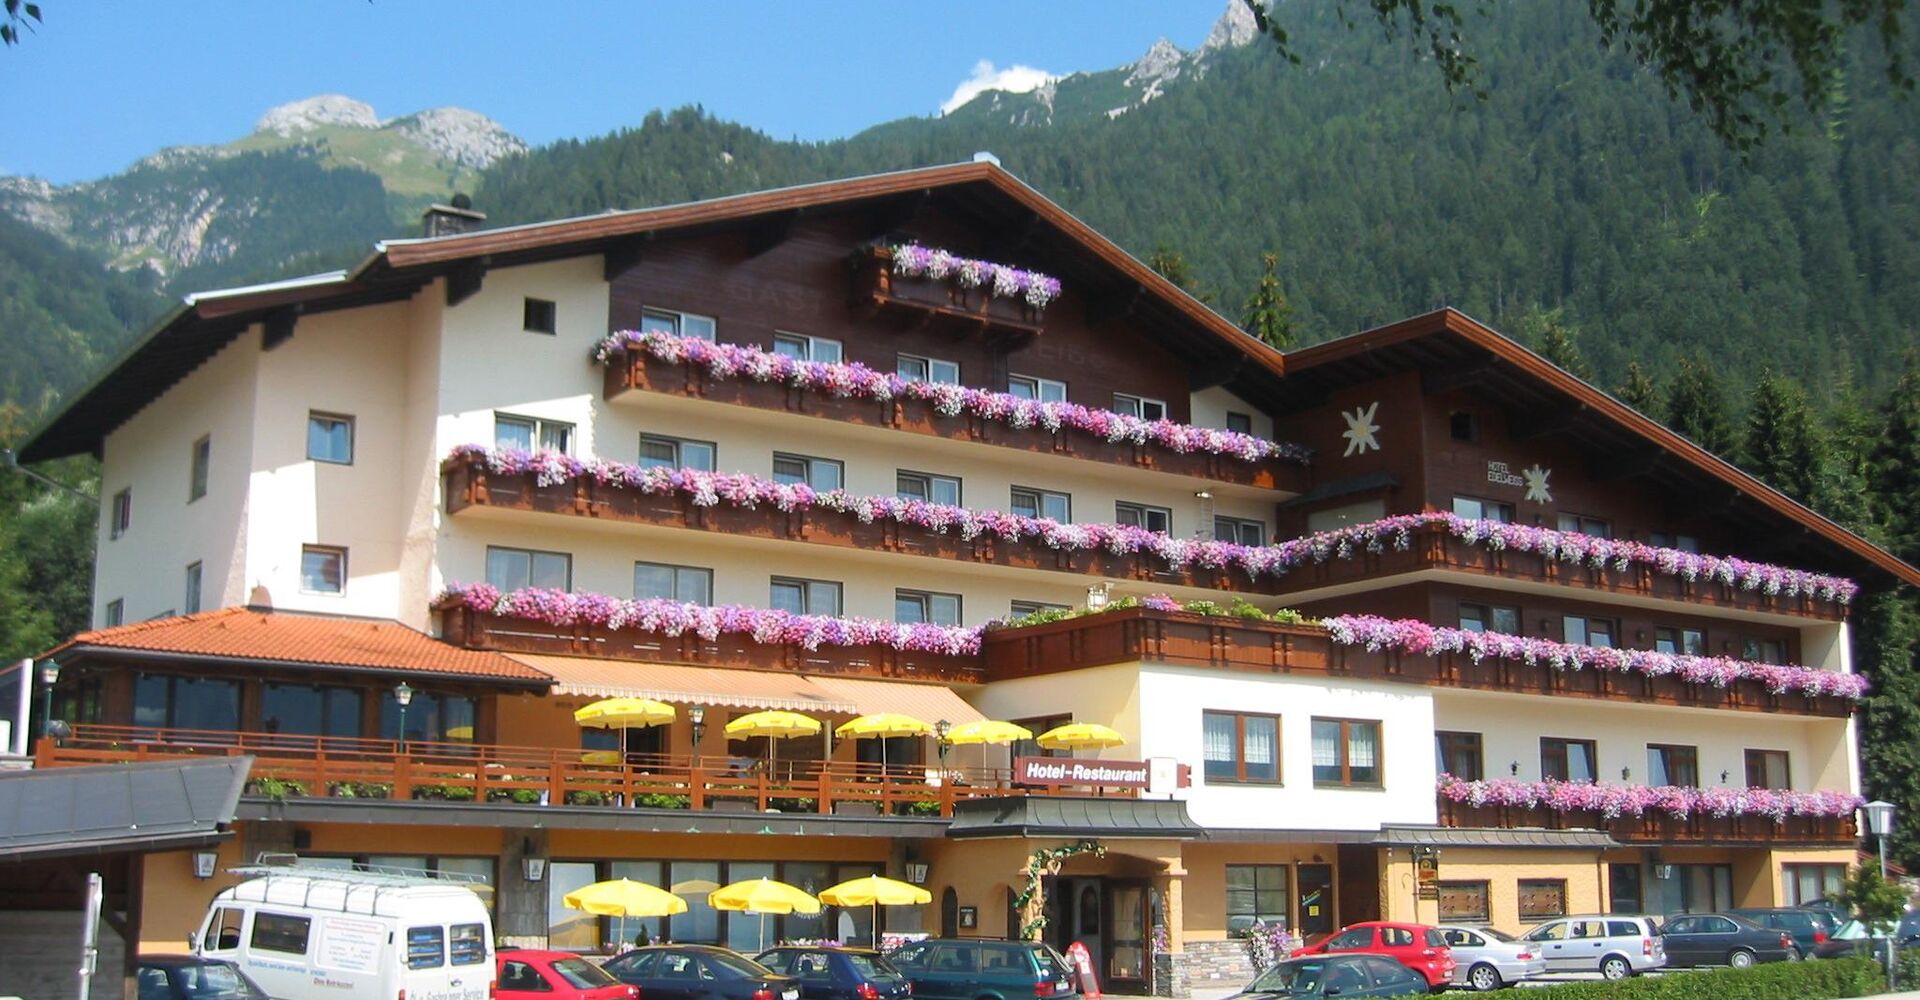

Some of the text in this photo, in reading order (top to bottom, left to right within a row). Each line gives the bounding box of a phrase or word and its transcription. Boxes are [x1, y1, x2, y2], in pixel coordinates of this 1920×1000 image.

[1487, 460, 1509, 474] HOTEL
[1487, 471, 1523, 486] EDELWEISS
[1026, 762, 1147, 783] Hotel-Restaurant
